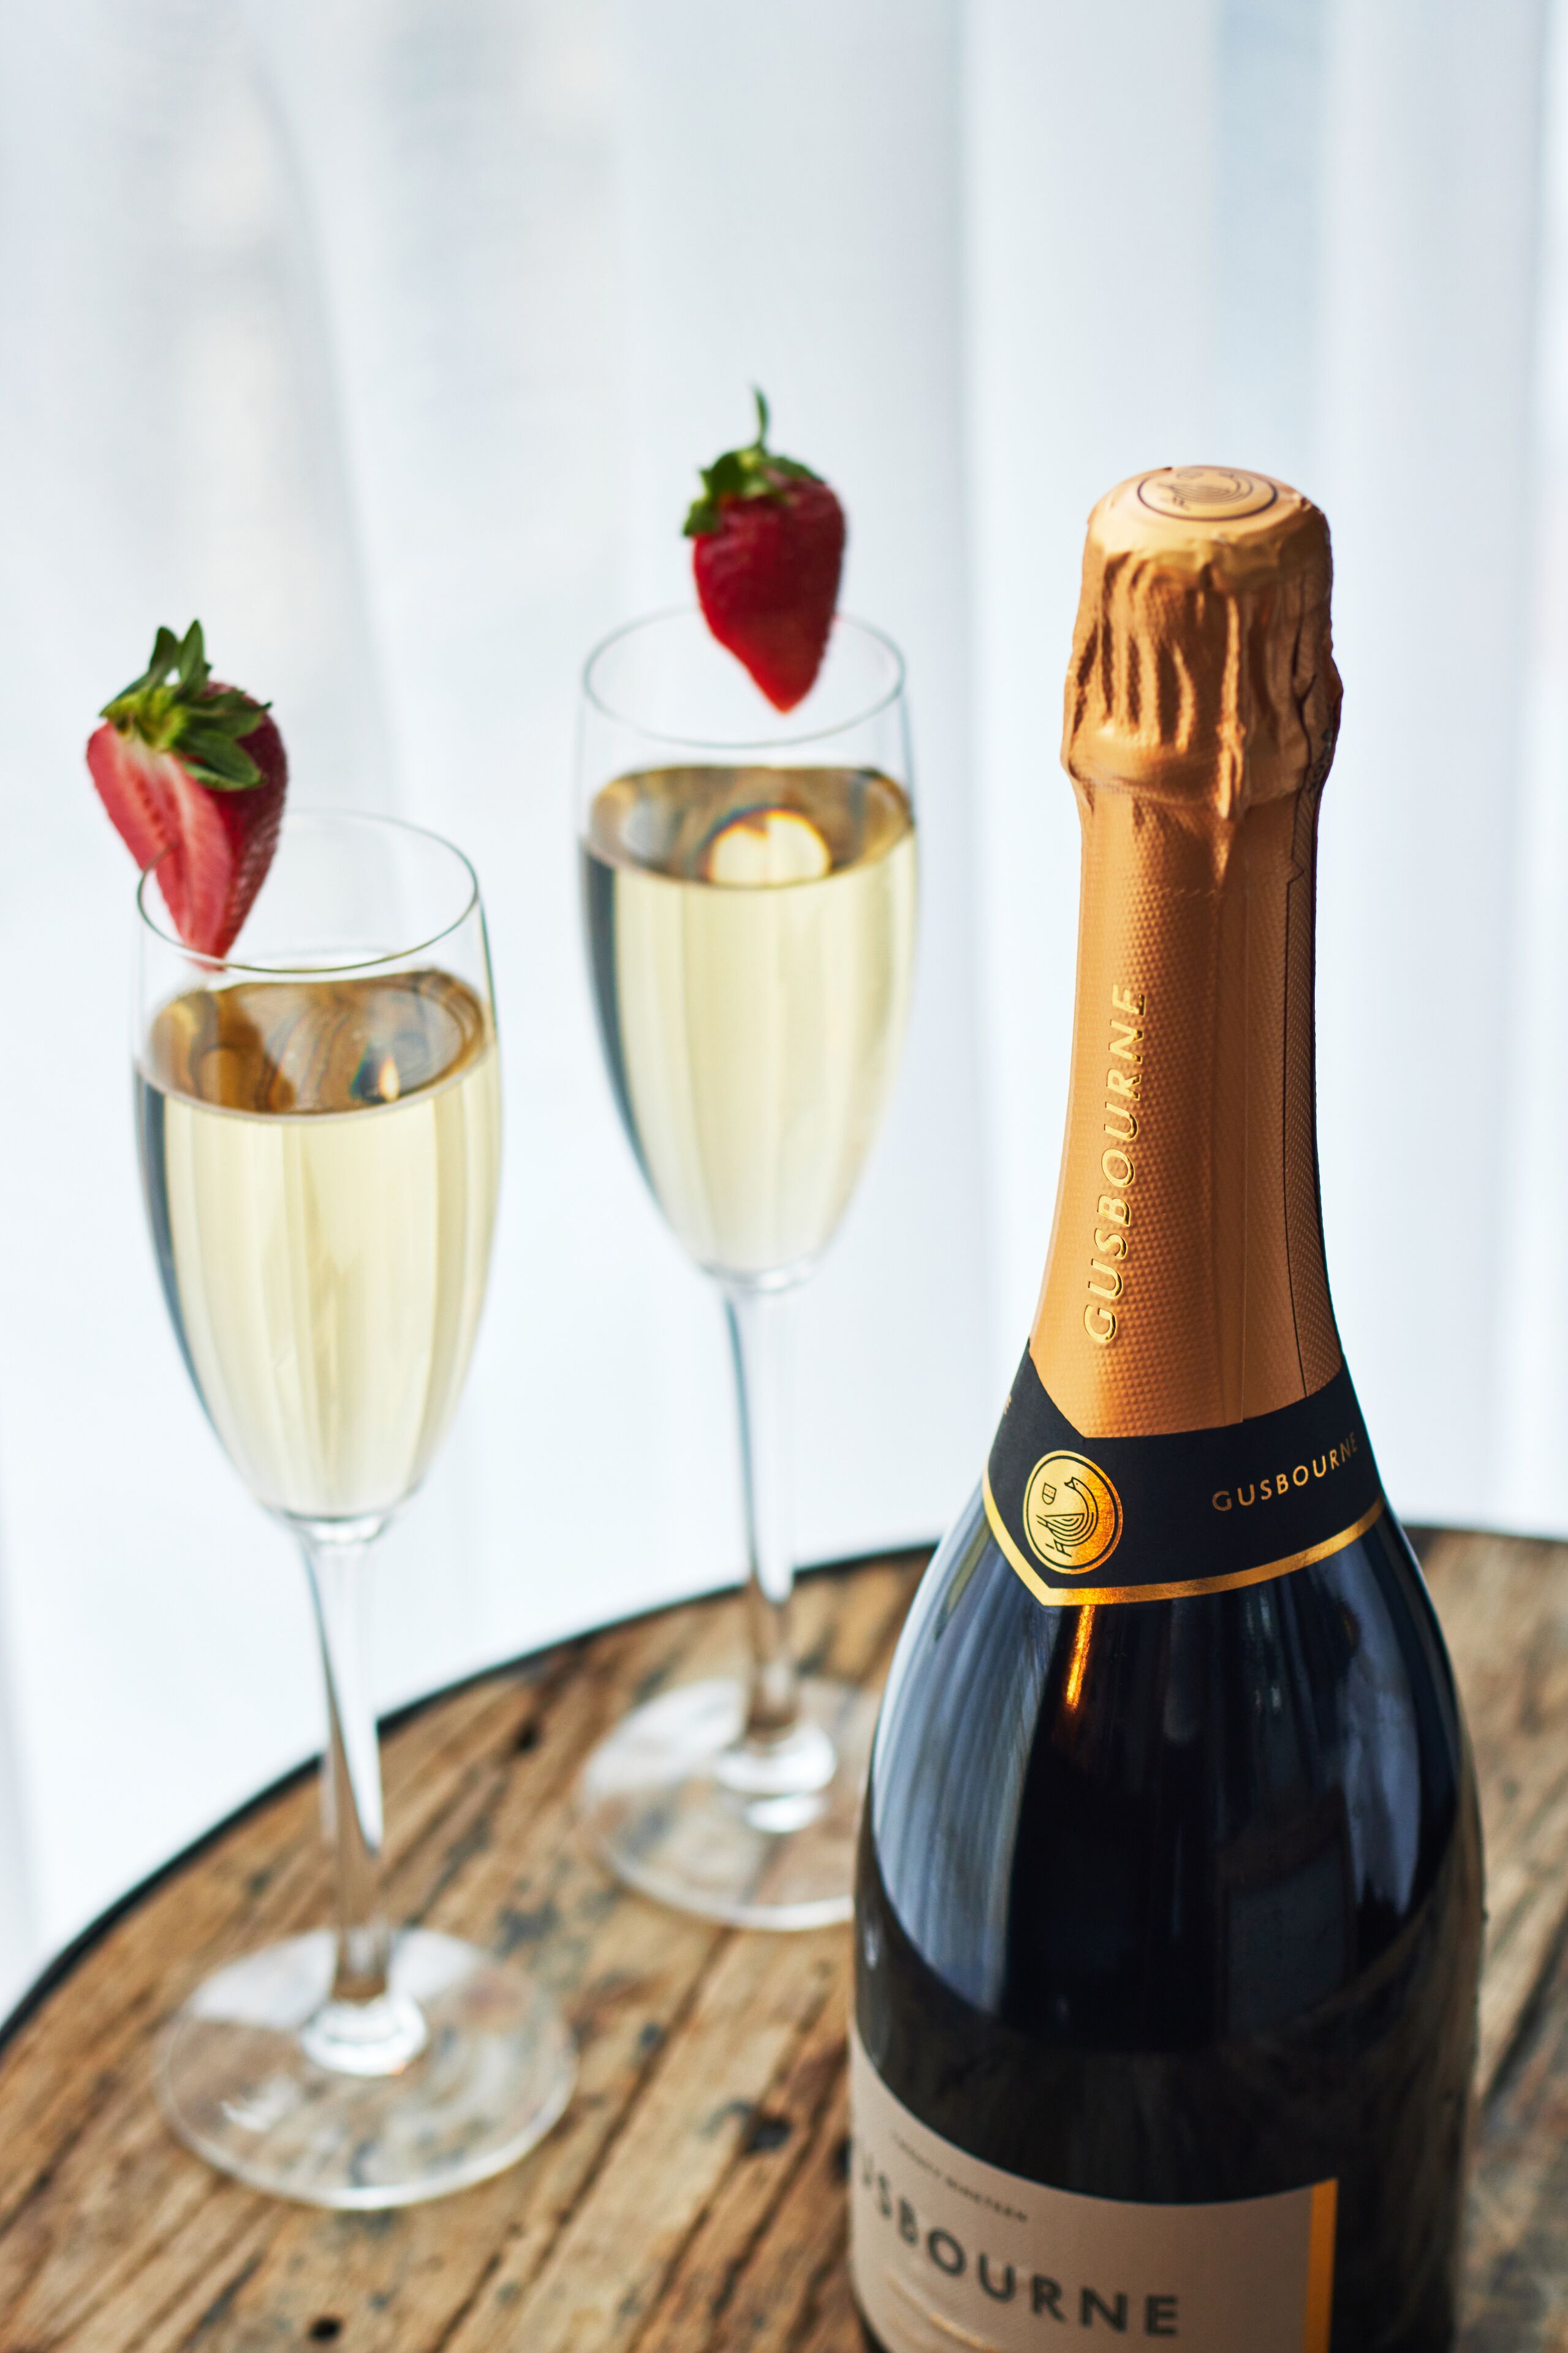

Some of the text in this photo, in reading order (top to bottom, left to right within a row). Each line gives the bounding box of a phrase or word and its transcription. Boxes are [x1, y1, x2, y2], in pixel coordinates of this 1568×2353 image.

[1084, 983, 1146, 1343] GUSBOURNE
[1212, 1431, 1358, 1511] GUSBOURNE
[860, 2153, 1178, 2337] USBOURNE
